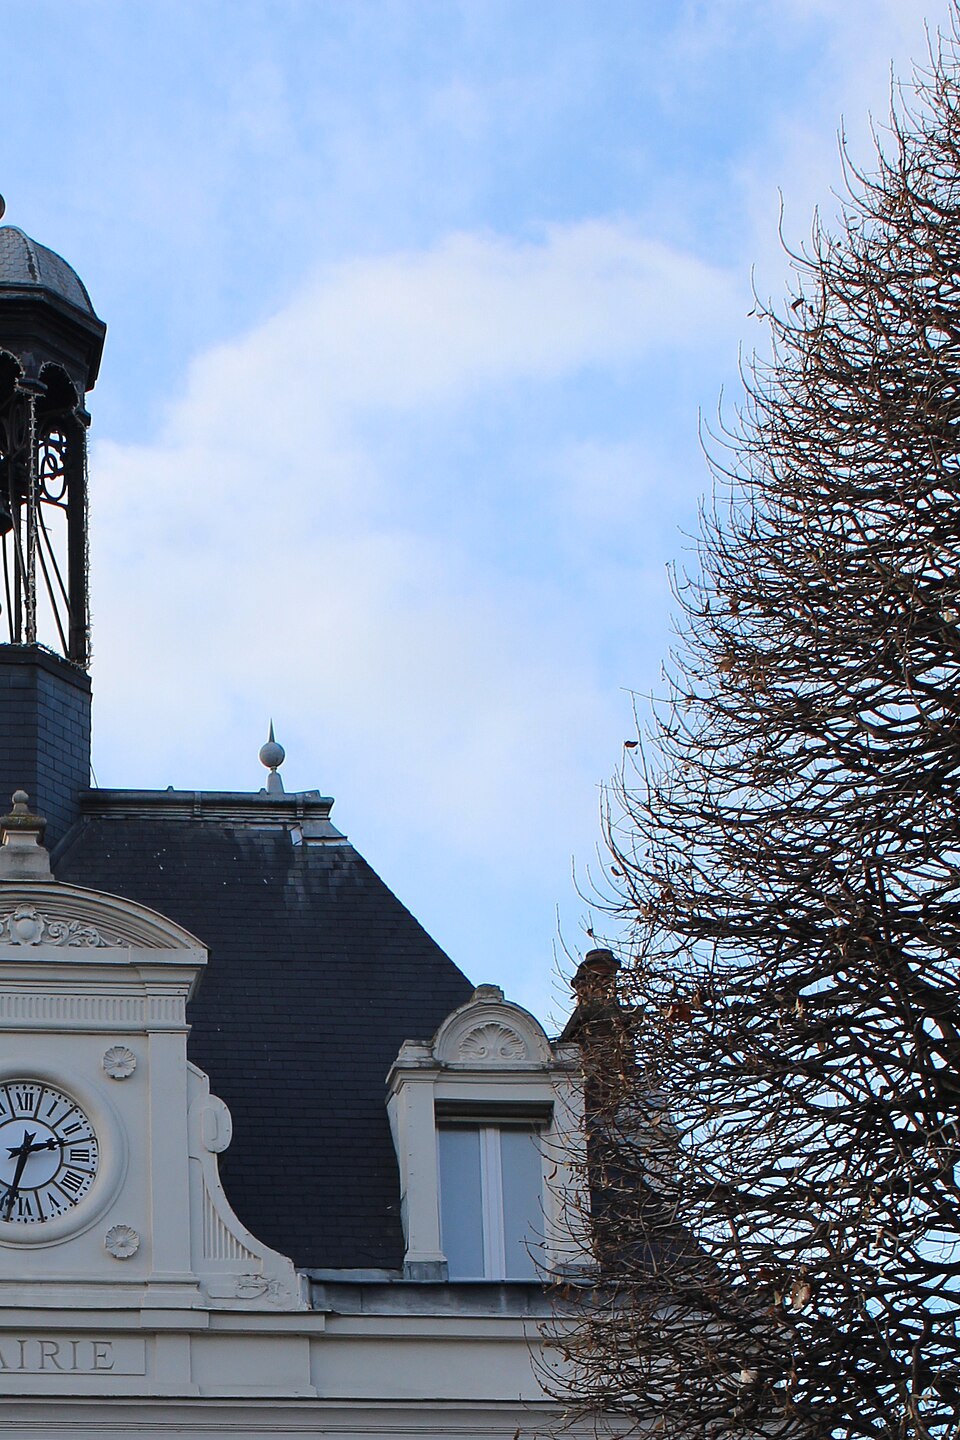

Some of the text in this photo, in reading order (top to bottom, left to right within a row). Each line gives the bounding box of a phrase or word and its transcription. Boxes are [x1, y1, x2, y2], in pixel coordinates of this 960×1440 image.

[15, 1092, 35, 1111] XII
[46, 1100, 59, 1118] I
[62, 1121, 83, 1136] II
[70, 1149, 90, 1163] III
[18, 1196, 33, 1216] VI
[47, 1192, 61, 1211] V
